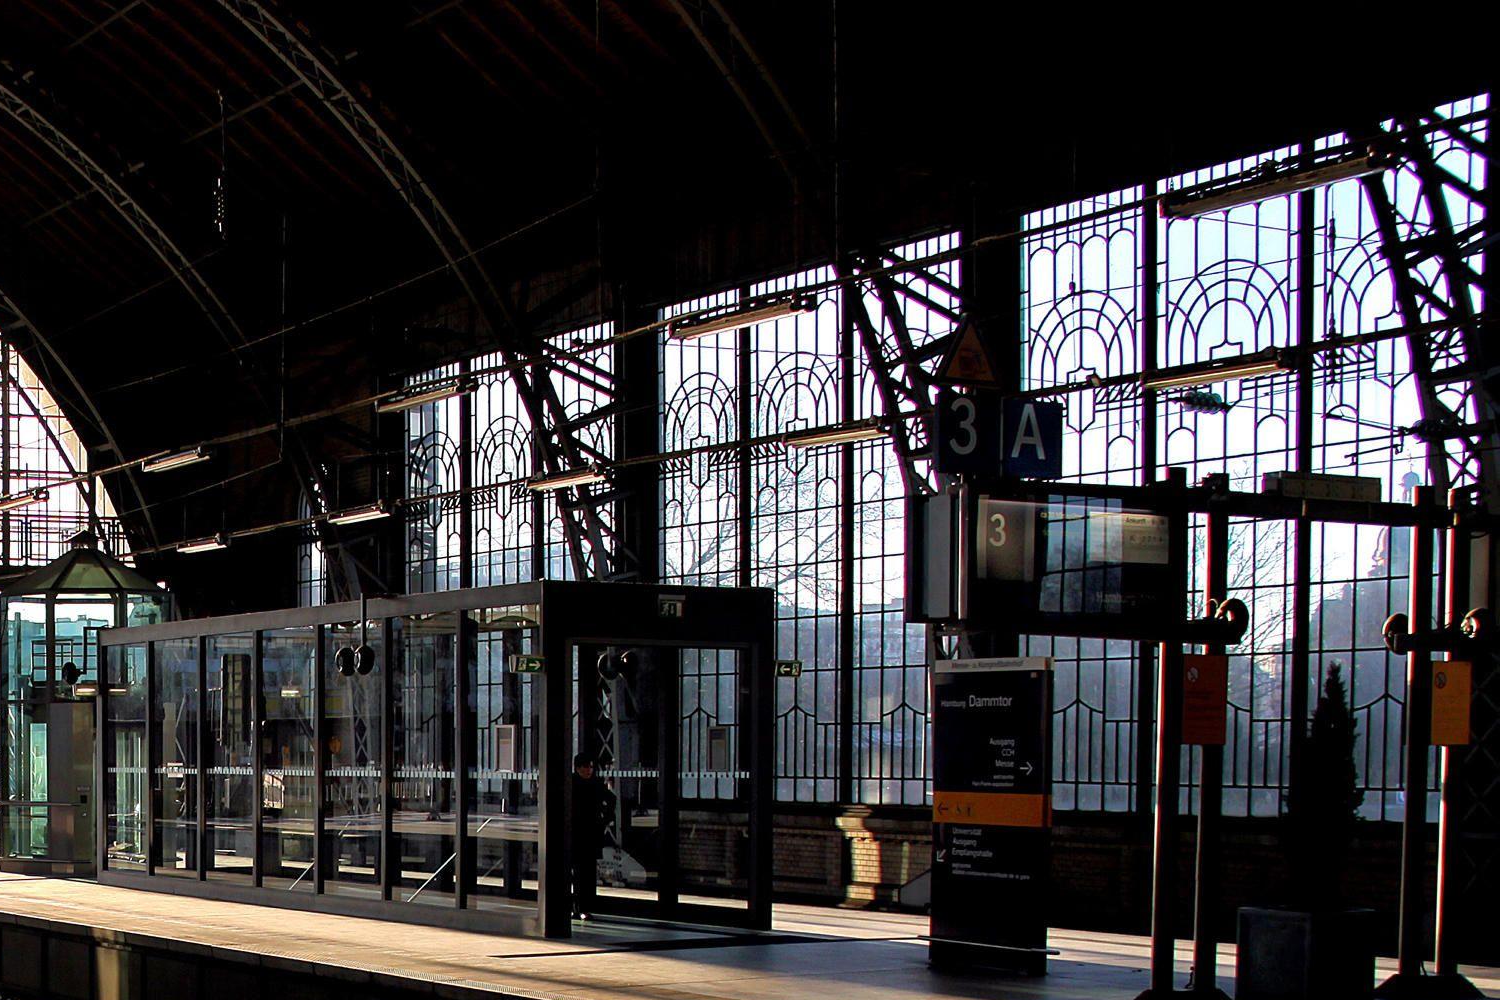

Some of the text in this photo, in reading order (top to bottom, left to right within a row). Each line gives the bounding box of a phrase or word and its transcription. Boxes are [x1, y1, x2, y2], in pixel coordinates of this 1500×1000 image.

[949, 397, 1047, 461] 3 A
[988, 513, 1007, 547] 3
[968, 694, 1013, 708] Dammtor
